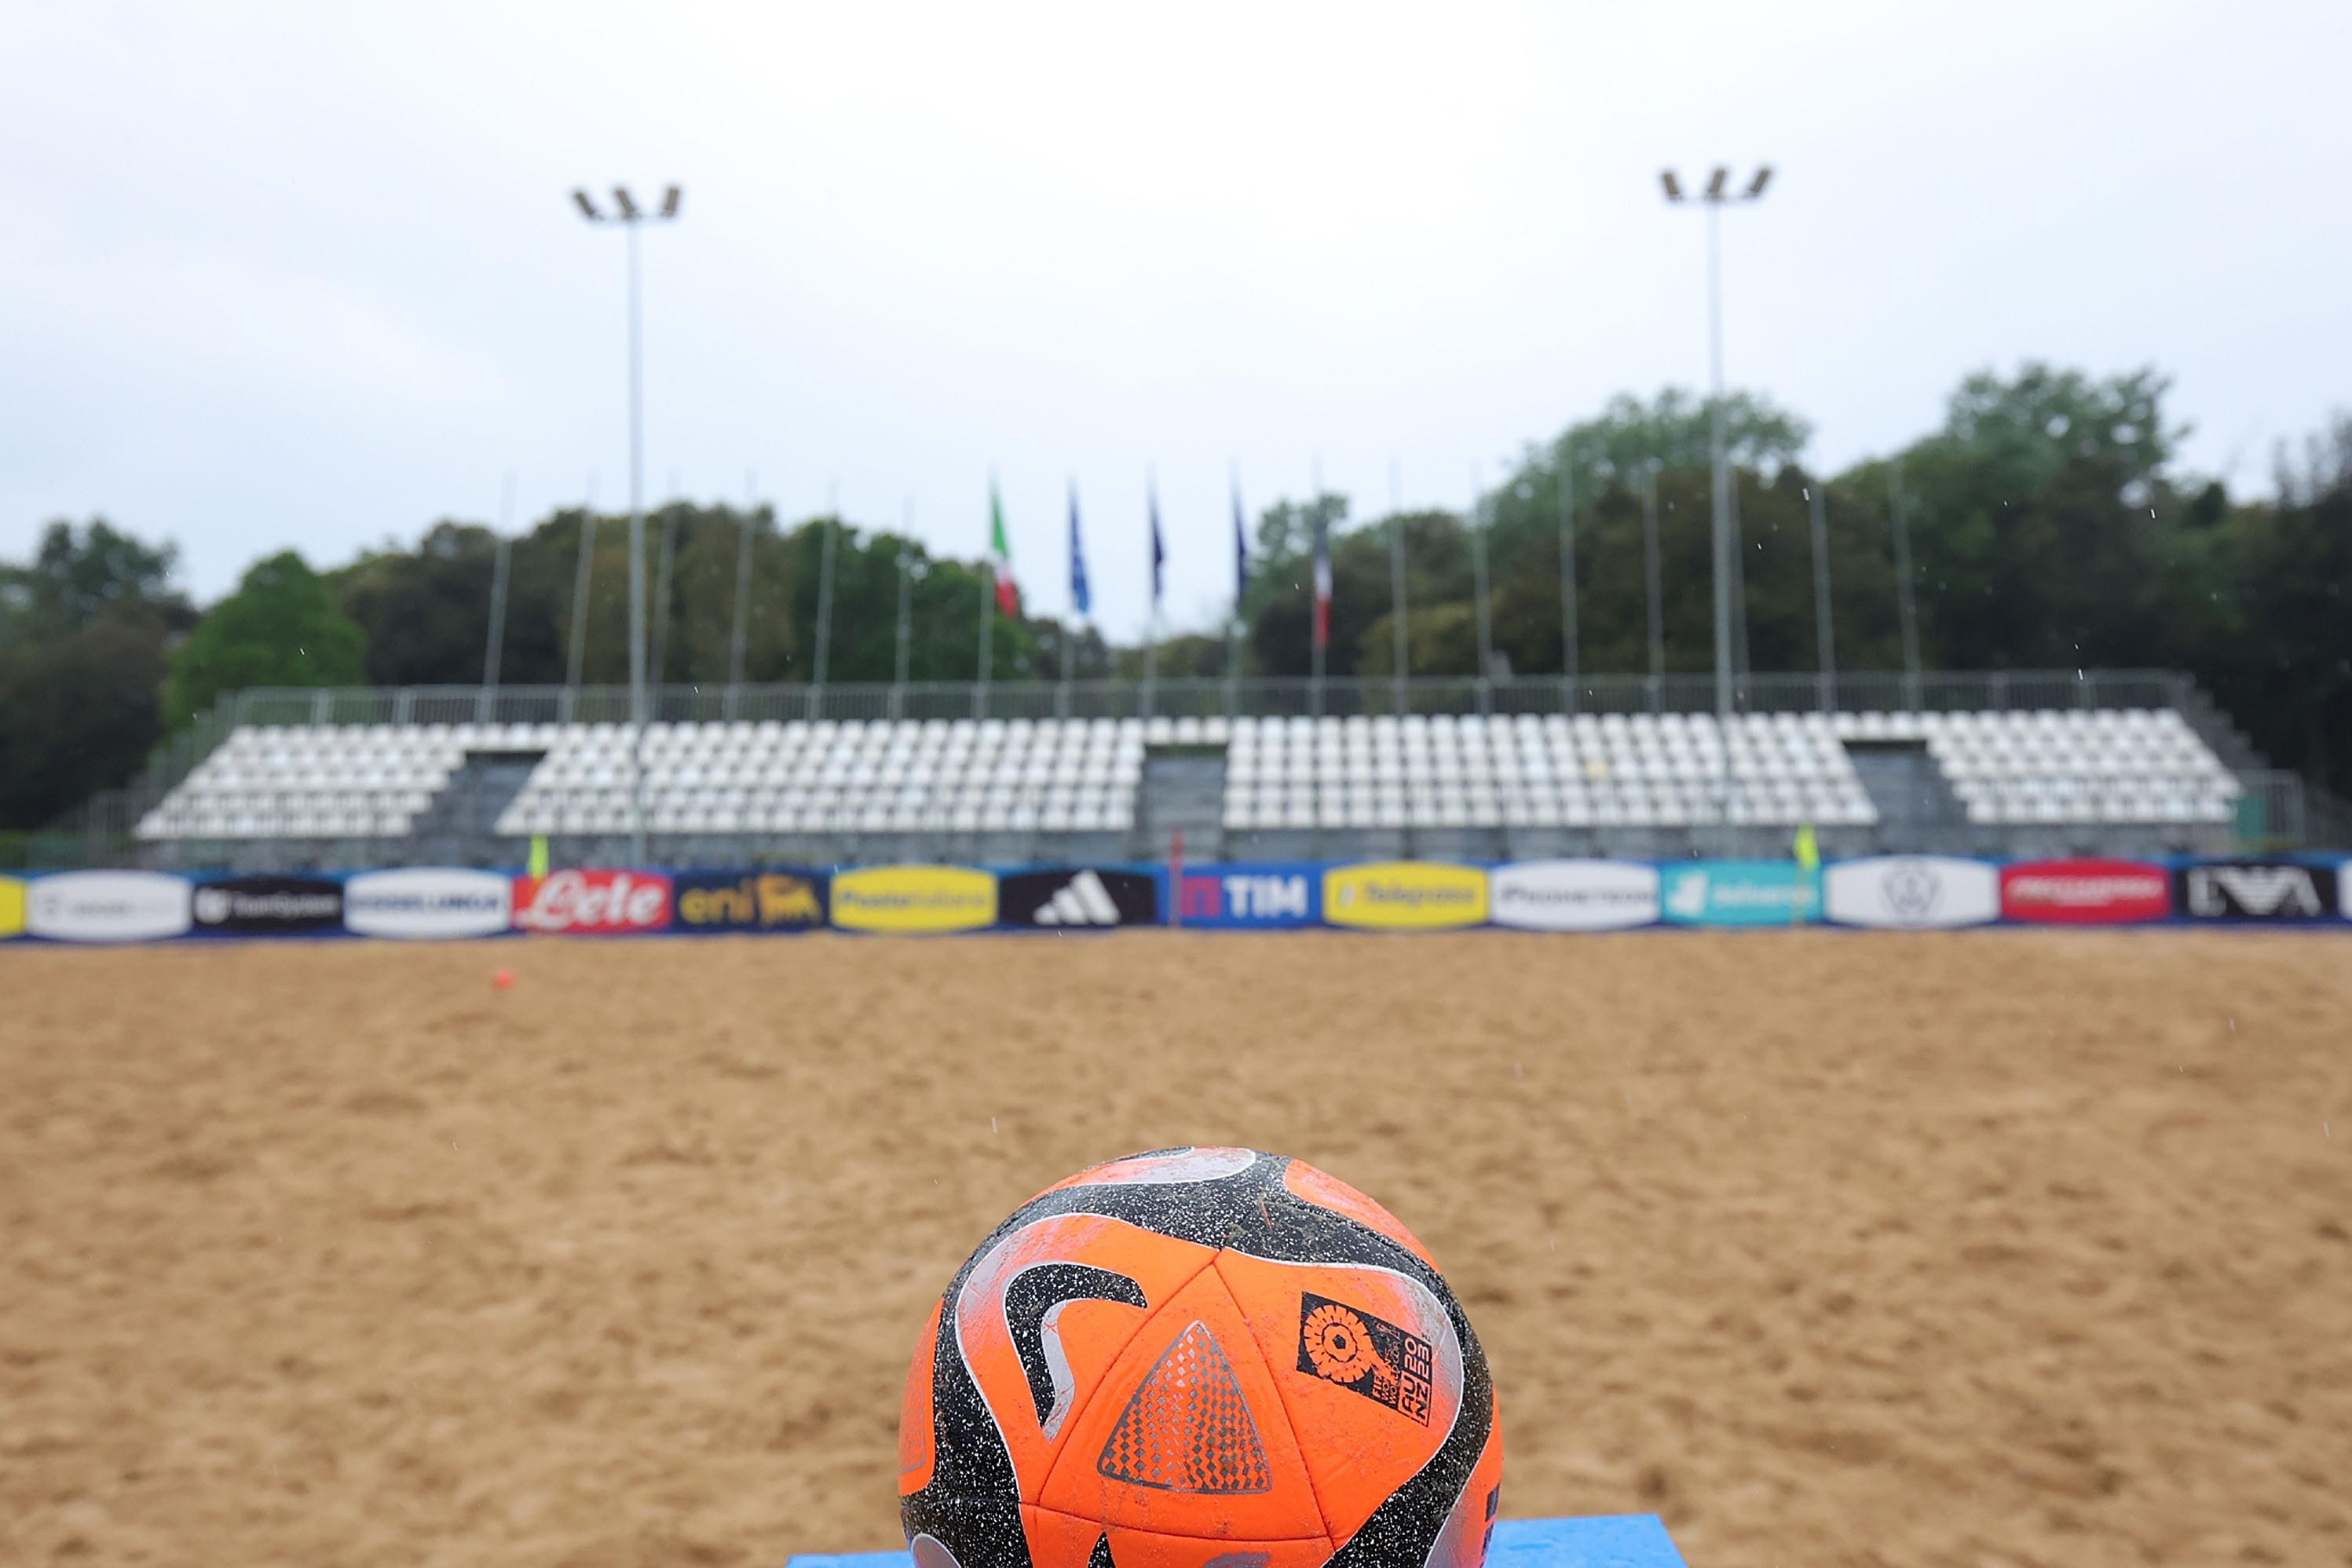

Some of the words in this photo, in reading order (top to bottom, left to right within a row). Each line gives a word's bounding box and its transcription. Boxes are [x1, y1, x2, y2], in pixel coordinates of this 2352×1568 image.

[513, 868, 664, 930] Lete
[679, 876, 755, 925] eni
[1224, 875, 1308, 919] TIM
[1404, 1337, 1417, 1372] 20
[1417, 1343, 1429, 1380] 23
[1402, 1375, 1415, 1413] AU
[1415, 1382, 1428, 1420] NZ
